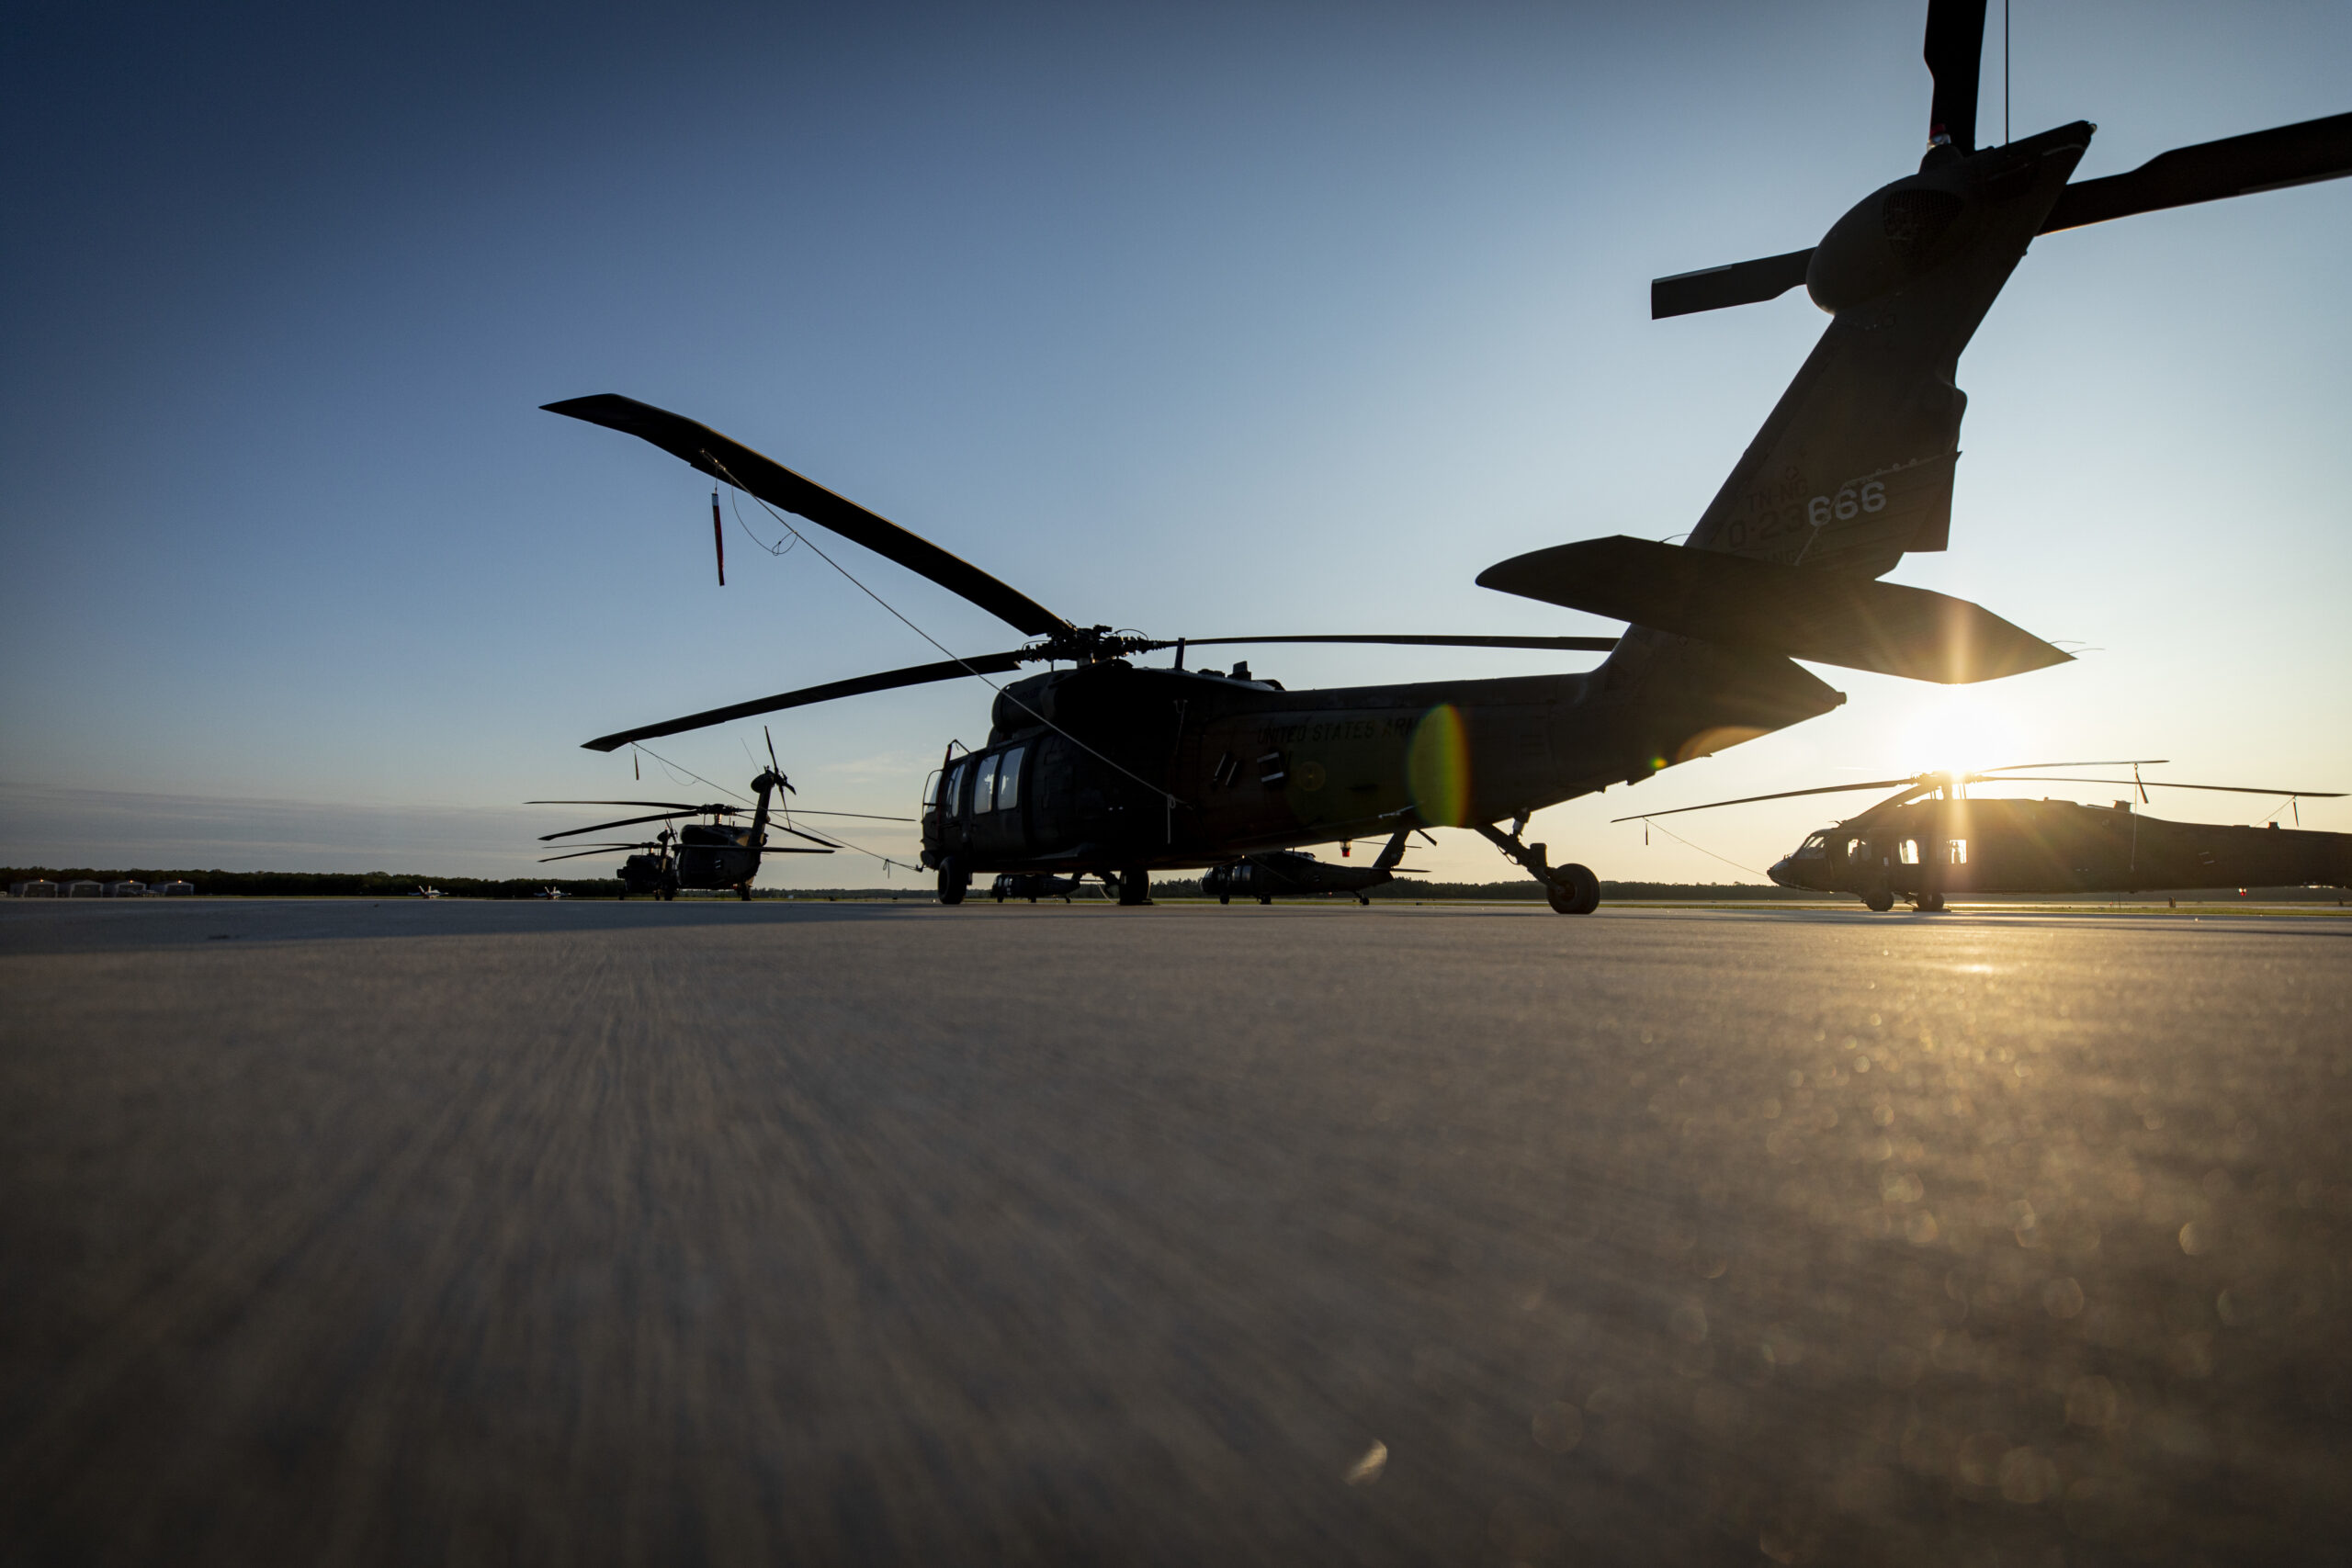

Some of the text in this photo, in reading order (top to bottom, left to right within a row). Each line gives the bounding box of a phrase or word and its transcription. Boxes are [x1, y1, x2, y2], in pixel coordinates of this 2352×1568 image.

[1807, 480, 1887, 527] 666
[1257, 716, 1430, 745] UNITED STATES ARM
